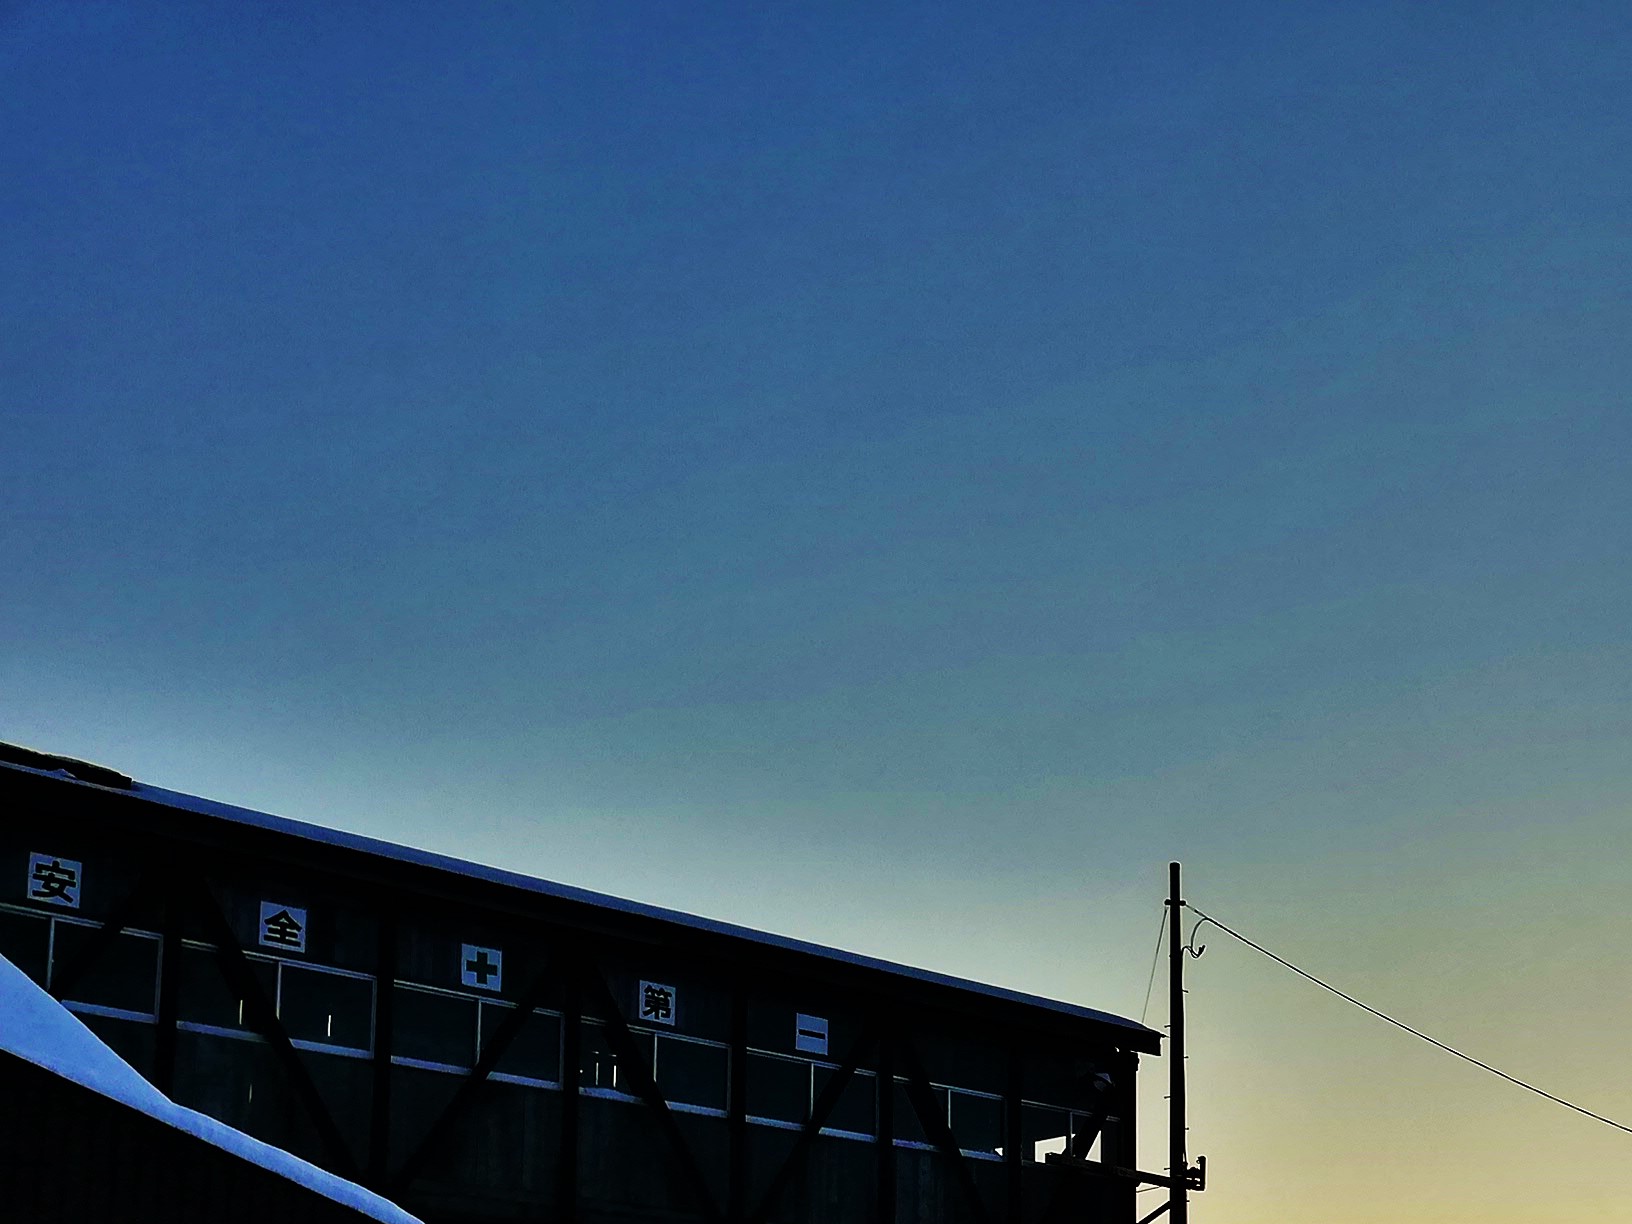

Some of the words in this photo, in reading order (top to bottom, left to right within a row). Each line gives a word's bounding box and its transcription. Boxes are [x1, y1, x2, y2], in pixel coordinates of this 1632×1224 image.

[32, 860, 76, 904] 安
[263, 909, 302, 947] 全
[643, 985, 673, 1019] 第
